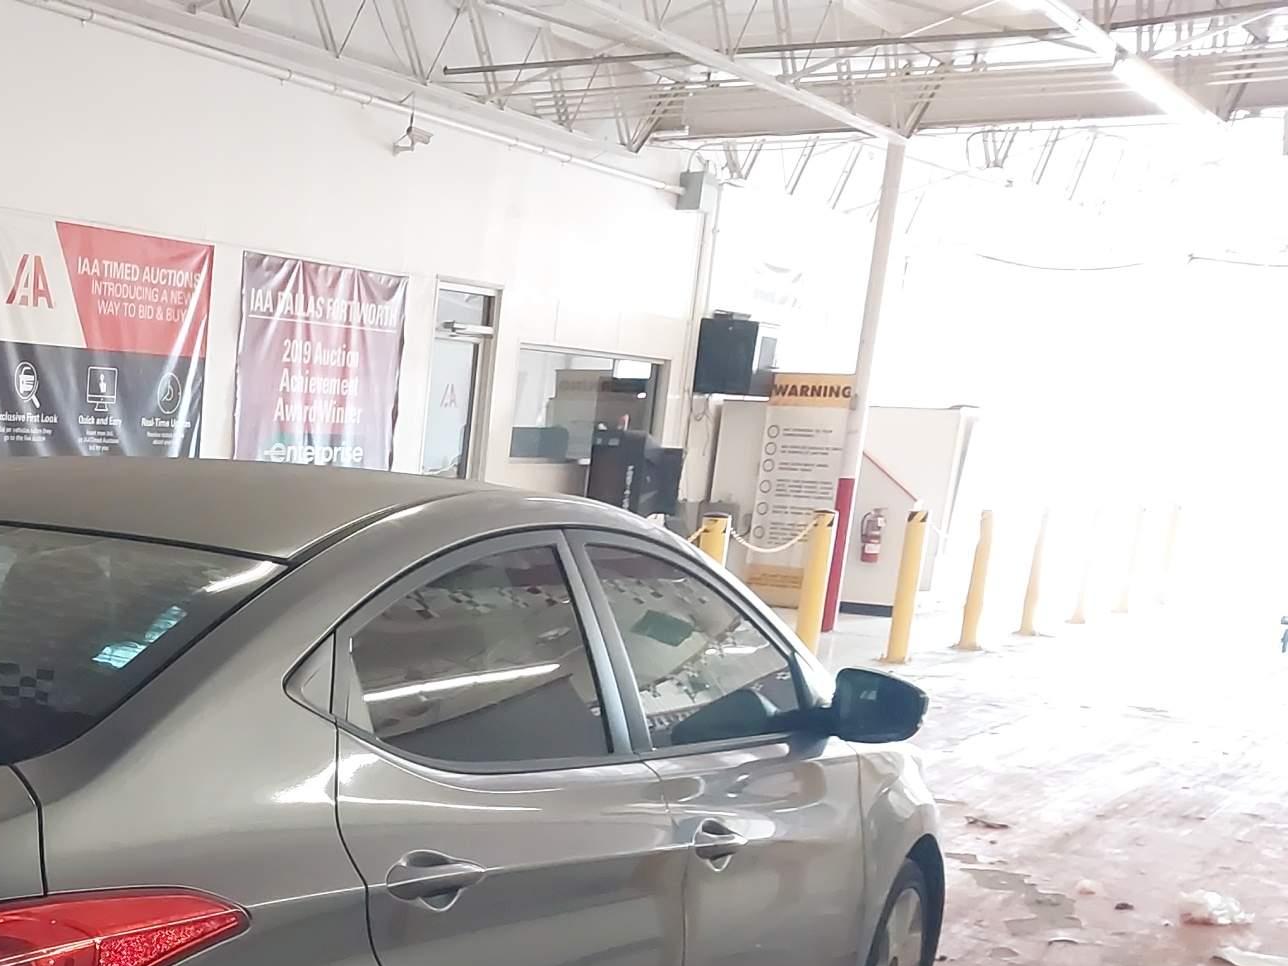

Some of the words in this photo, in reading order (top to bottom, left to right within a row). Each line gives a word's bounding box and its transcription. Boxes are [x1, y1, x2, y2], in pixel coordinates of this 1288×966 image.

[77, 256, 101, 276] IAA
[102, 260, 140, 282] TIMED
[142, 266, 202, 289] AUCTIONS
[91, 280, 160, 303] INTRODUCING
[161, 290, 169, 303] A
[98, 300, 120, 316] WAY
[122, 302, 136, 318] TO
[138, 304, 154, 319] BID
[155, 306, 164, 320] &
[166, 306, 188, 322] BUY
[250, 288, 274, 313] IAA
[326, 298, 354, 323] FORT
[355, 302, 398, 328] WORTH
[282, 338, 312, 364] 2019
[313, 342, 360, 369] Auction
[279, 367, 359, 397] Achievement
[772, 383, 852, 399] WARNING
[26, 412, 40, 423] First
[41, 412, 58, 424] Look
[78, 414, 95, 425] Quick
[96, 415, 108, 425] and
[109, 416, 122, 428] Easy
[141, 417, 169, 428] Real-Time
[273, 397, 318, 423] Award
[318, 399, 363, 425] Winner
[265, 441, 364, 465] enterprise
